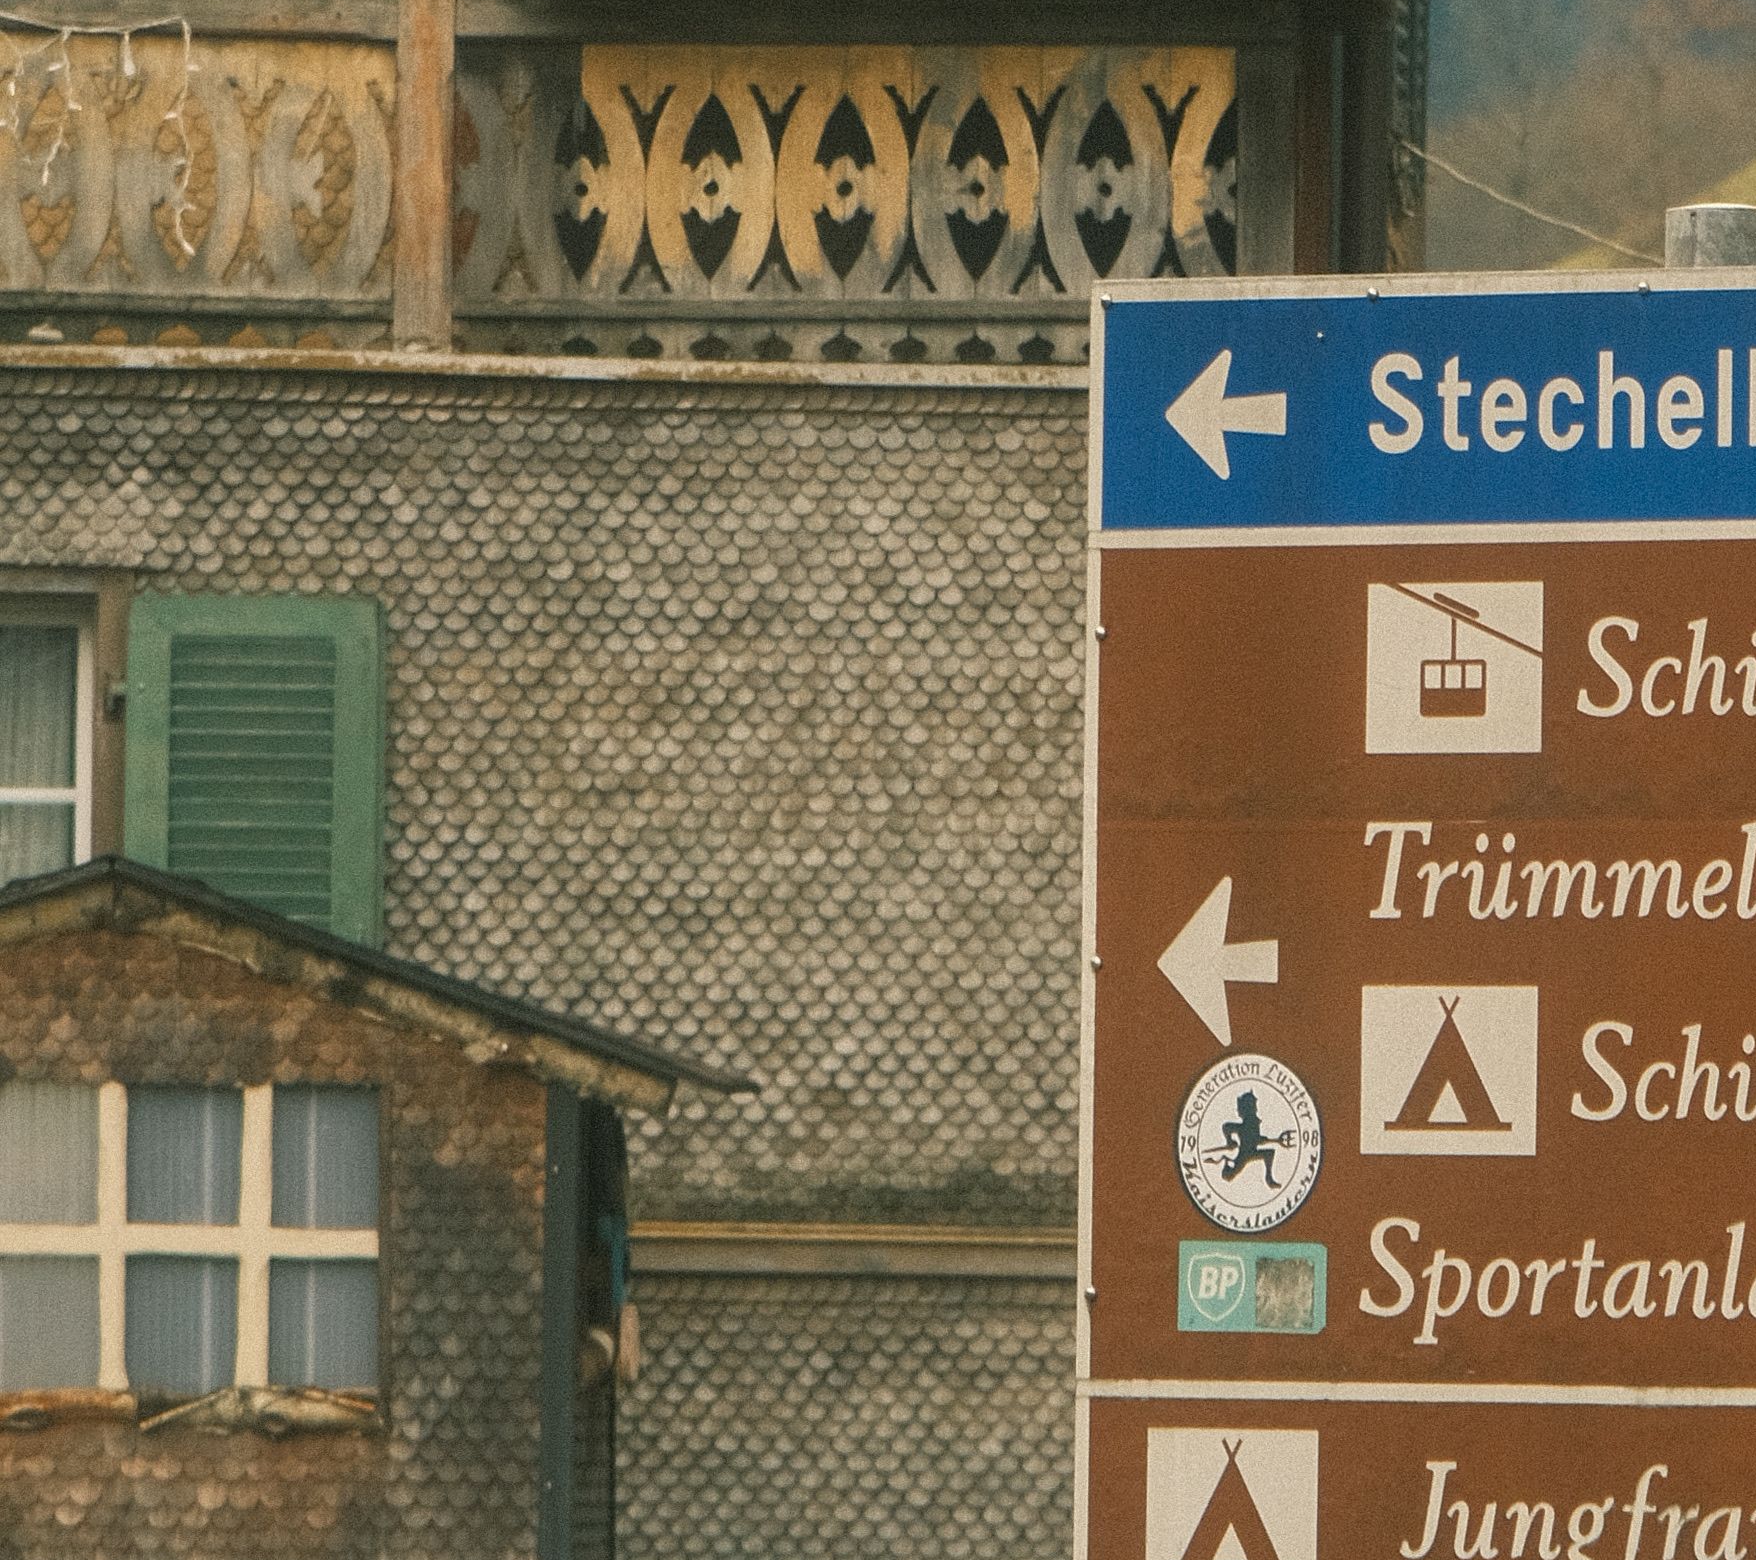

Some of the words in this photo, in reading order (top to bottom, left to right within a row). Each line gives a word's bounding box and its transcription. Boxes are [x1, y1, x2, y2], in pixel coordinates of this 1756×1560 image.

[1184, 1062, 1260, 1129] Generation
[1180, 1135, 1197, 1154] 19
[1302, 1130, 1319, 1148] 98
[1182, 1150, 1319, 1230] Kaiserslautern
[1198, 1264, 1240, 1300] BP
